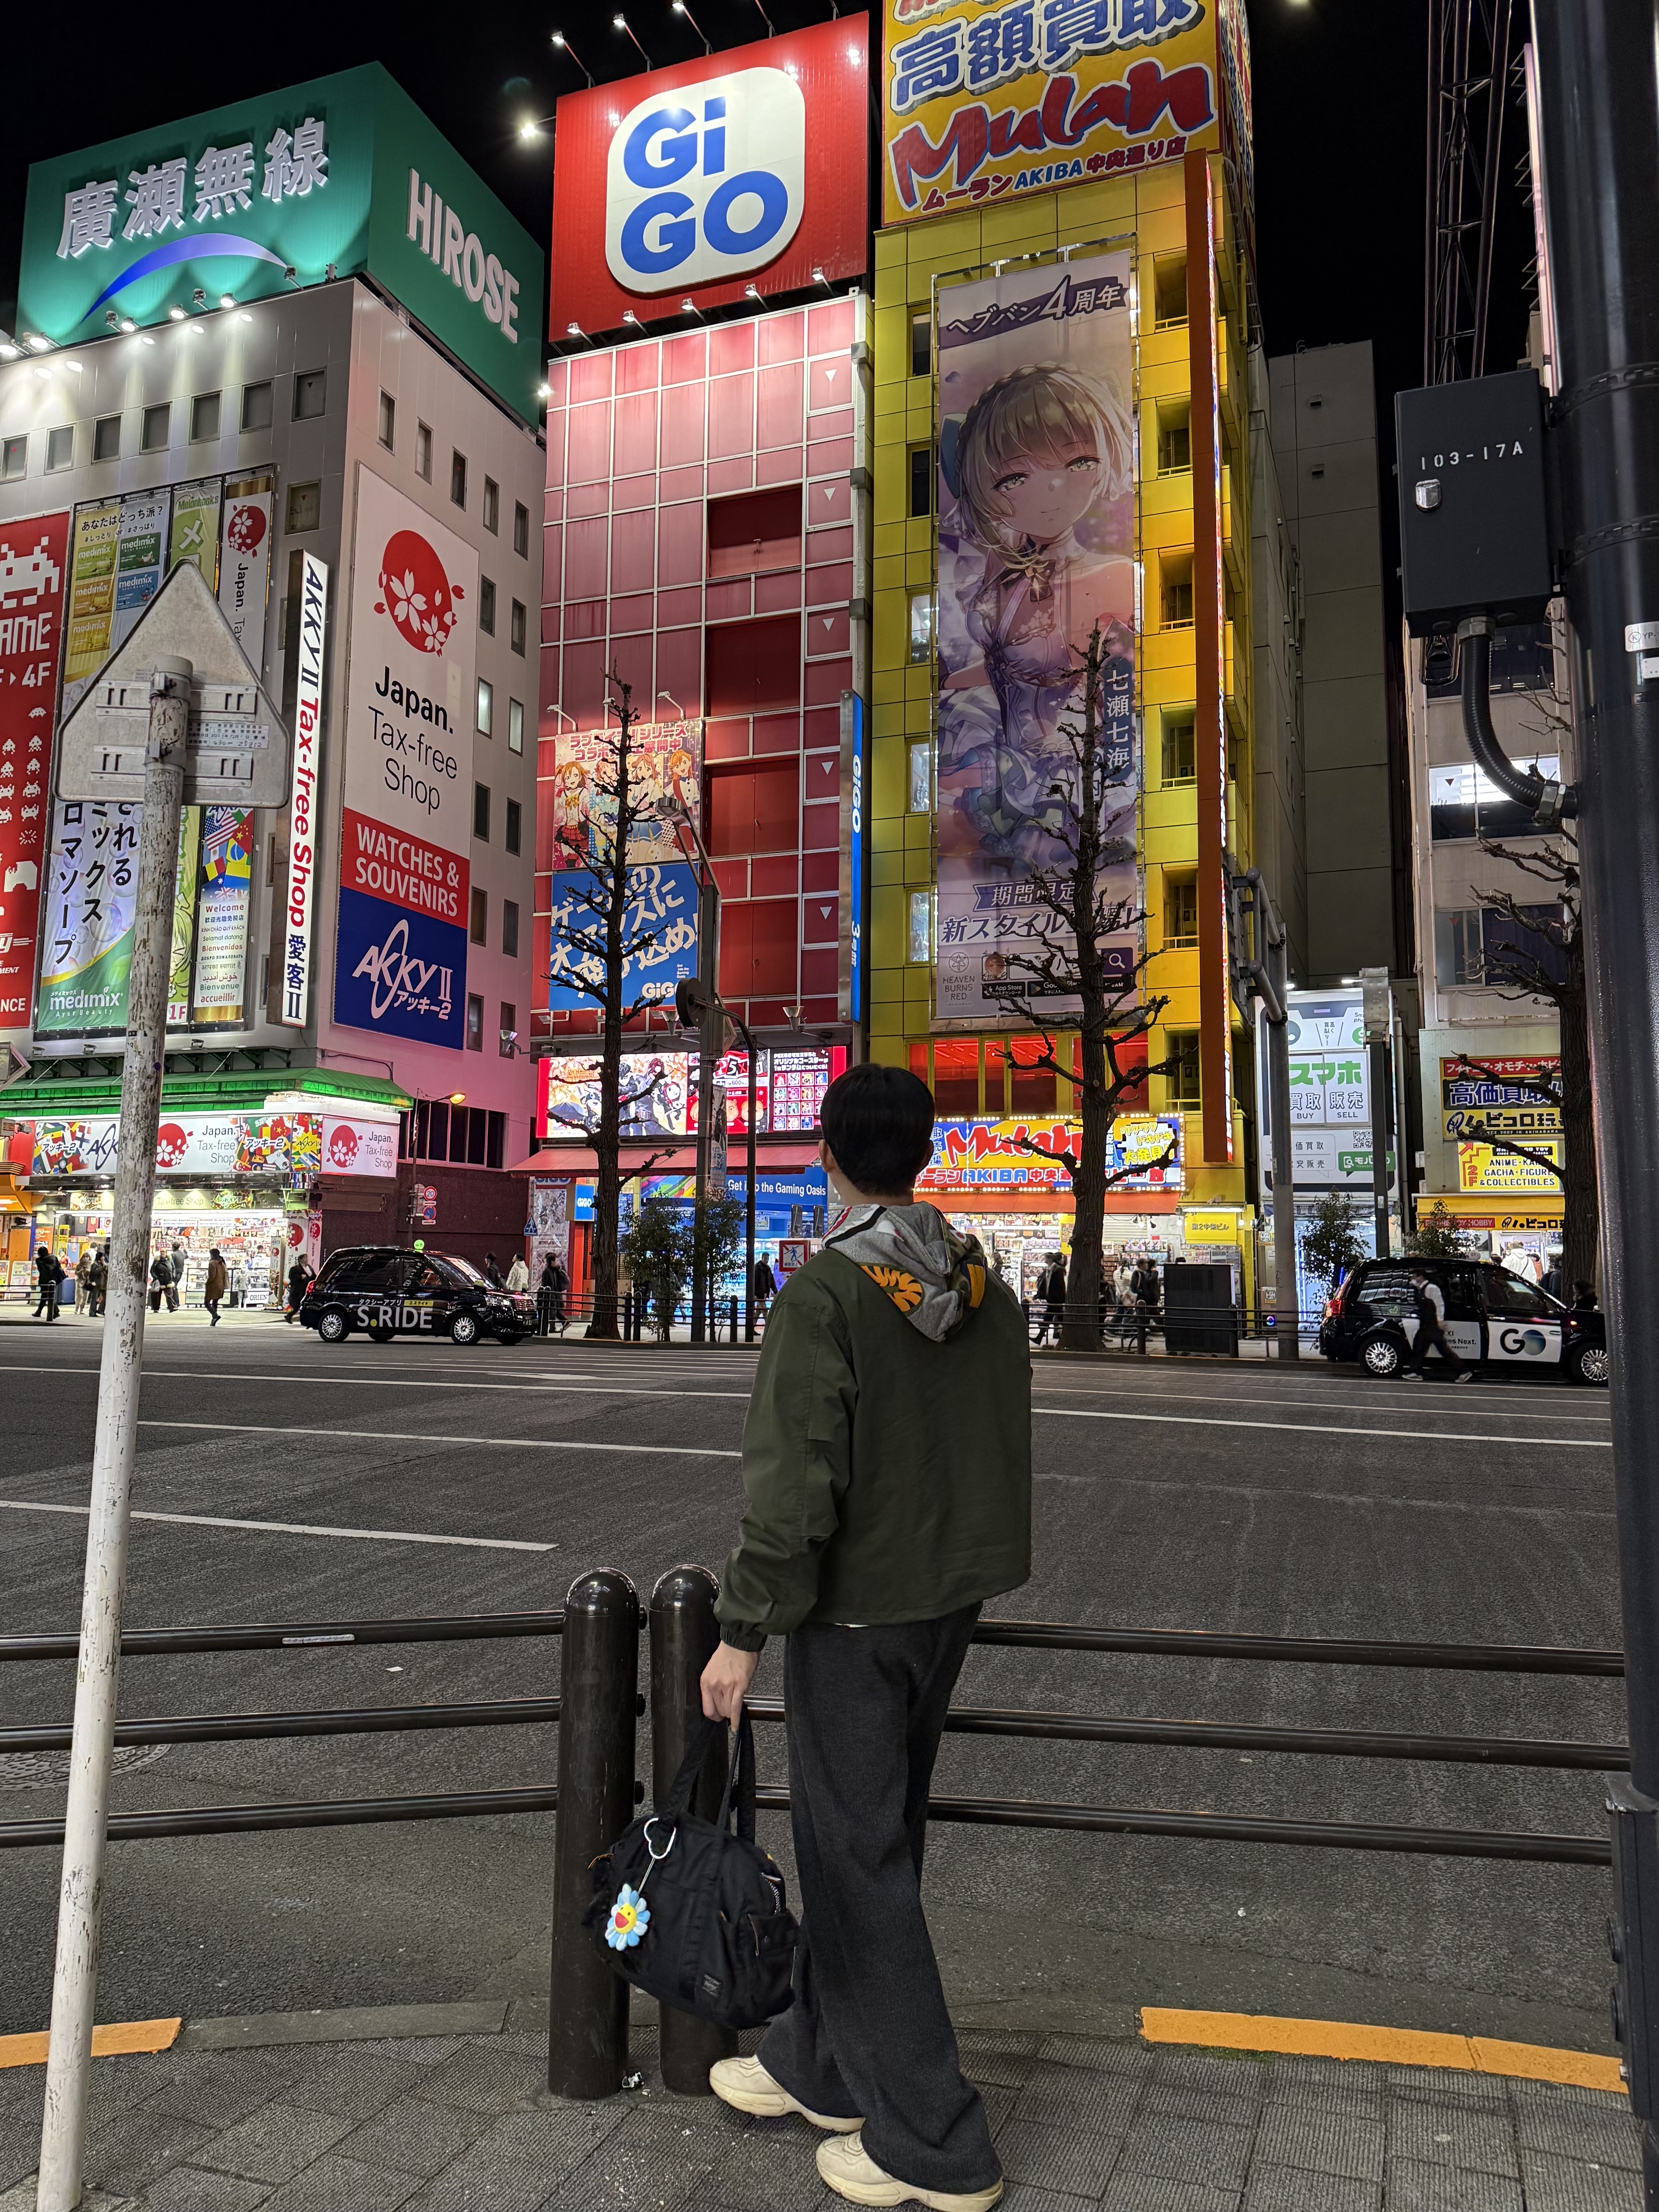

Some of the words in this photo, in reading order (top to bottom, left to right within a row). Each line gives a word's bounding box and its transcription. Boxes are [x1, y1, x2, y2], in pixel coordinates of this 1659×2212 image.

[624, 96, 726, 189] Gi
[892, 61, 1214, 208] Mulan
[621, 171, 788, 274] GO
[406, 168, 520, 343] HIROSE
[948, 275, 1122, 334] ヘブバン4周年
[178, 495, 218, 511] Melonbooks
[121, 535, 155, 550] medimix
[78, 544, 111, 559] medimix
[119, 574, 152, 588] medimix
[235, 562, 249, 612] Japan.
[76, 582, 108, 597] medimix
[374, 666, 454, 734] Japan.
[368, 706, 457, 780] Tax-free
[294, 698, 318, 836] Tax-free
[385, 758, 440, 815] Shop
[852, 754, 862, 833] GiGO
[357, 823, 443, 882] WATCHES
[447, 862, 459, 888] &
[289, 842, 312, 928] Shop
[355, 857, 457, 917] SOUVENIRS
[205, 904, 244, 913] Welcome
[200, 983, 239, 991] Bienvenue
[943, 975, 975, 984] HEAVEN
[642, 982, 679, 998] GiG
[945, 984, 974, 992] BURNS
[49, 986, 121, 1010] medimix
[201, 993, 235, 1003] accueillir
[394, 990, 452, 1021] アッキー2
[169, 1004, 186, 1020] 1F
[1289, 1060, 1362, 1086] スマホ
[1289, 1092, 1321, 1110] 買取
[1329, 1091, 1363, 1110] 販売
[203, 1125, 235, 1138] Japan.
[368, 1131, 393, 1144] Japan.
[42, 1142, 77, 1153] アッキー2
[197, 1140, 235, 1150] Tax-free
[245, 1136, 285, 1148] アッキー2
[1295, 1141, 1324, 1151] 価買取
[365, 1144, 393, 1157] Tax-free
[211, 1153, 235, 1165] Shop
[375, 1157, 392, 1170] Shop
[1292, 1159, 1325, 1169] 安販売
[728, 1179, 742, 1191] Get
[744, 1180, 759, 1191] io
[760, 1180, 774, 1192] the
[775, 1182, 805, 1197] Gaming
[806, 1184, 826, 1196] Oasis
[577, 1197, 592, 1207] GiGO
[1468, 1218, 1492, 1227] HOBBY
[357, 1306, 433, 1329] S.RIDE
